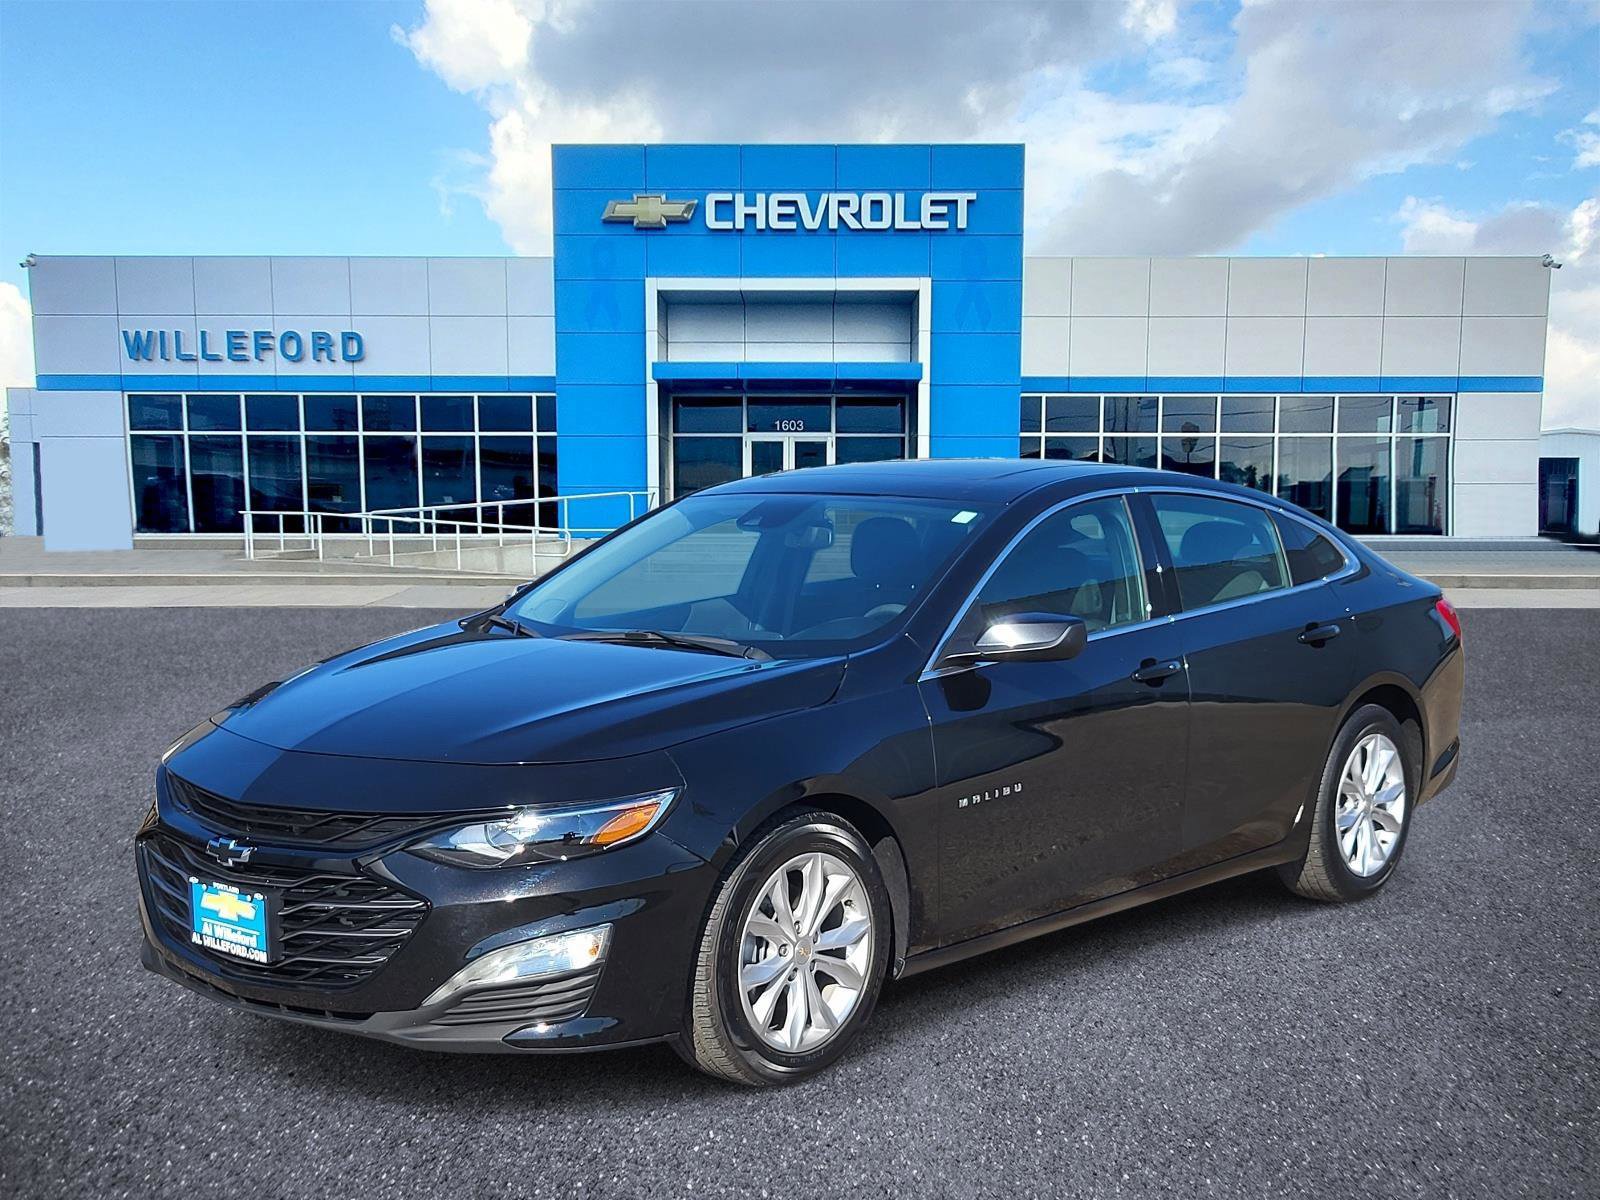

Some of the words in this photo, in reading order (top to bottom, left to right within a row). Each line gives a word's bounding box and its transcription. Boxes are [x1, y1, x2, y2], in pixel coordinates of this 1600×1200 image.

[705, 192, 977, 230] CHEVROLET
[122, 329, 366, 363] WILLEFORD
[774, 419, 804, 431] 1603
[958, 783, 1022, 808] MALIBU
